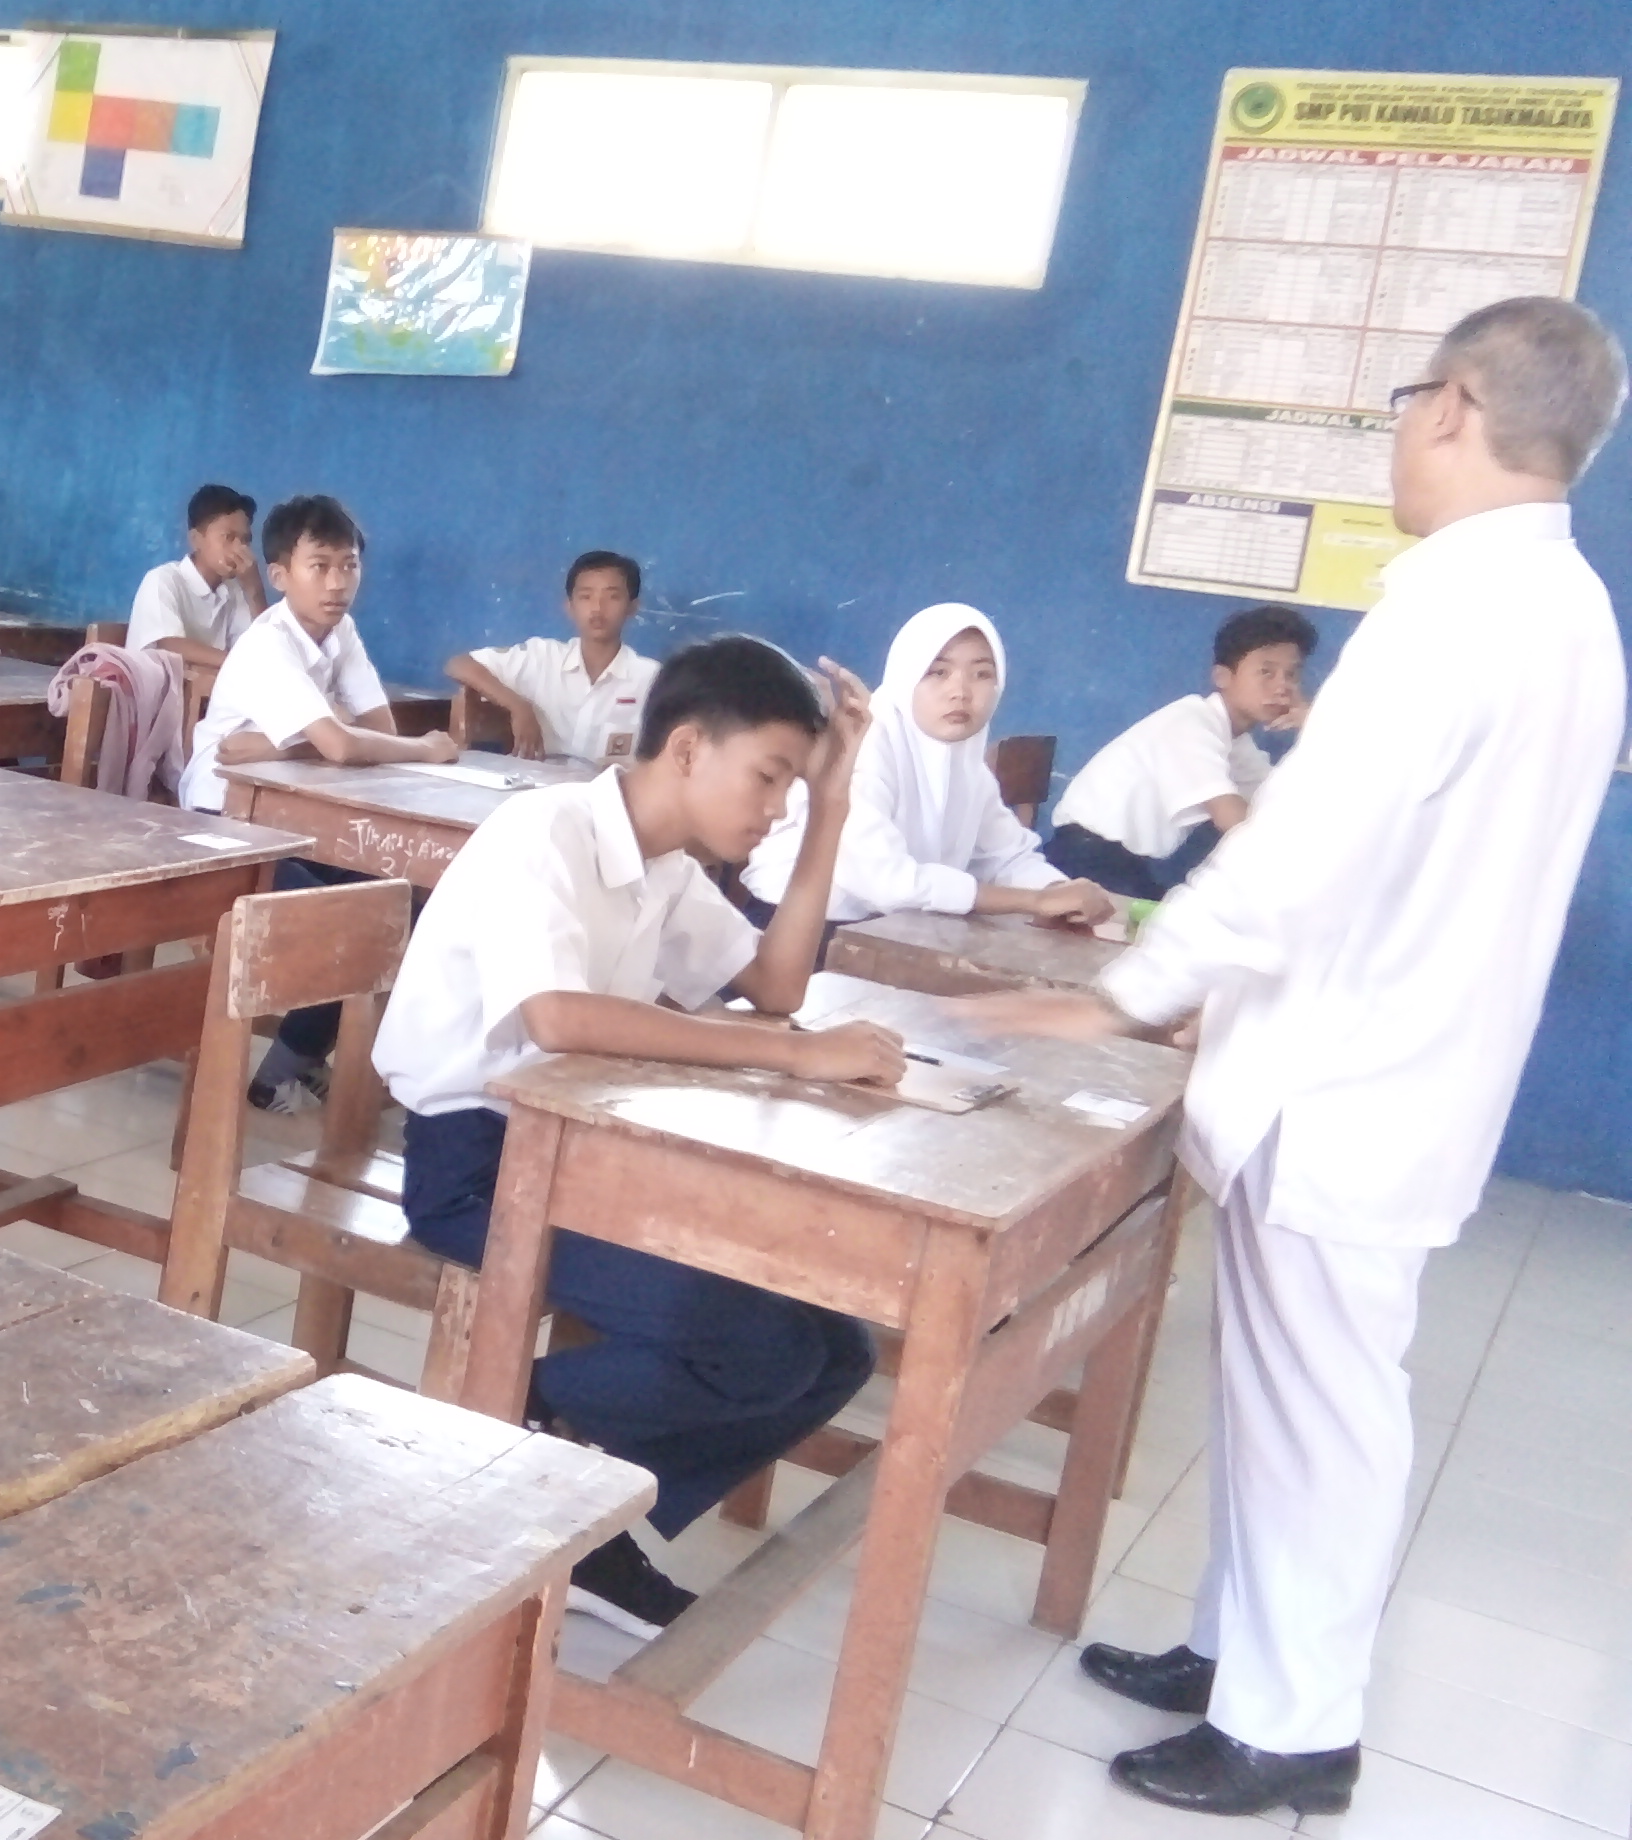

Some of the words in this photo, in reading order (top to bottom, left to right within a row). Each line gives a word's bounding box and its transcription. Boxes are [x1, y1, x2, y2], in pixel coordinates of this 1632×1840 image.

[1294, 101, 1336, 121] SMP
[1461, 106, 1594, 129] TASIKMALAYA
[1236, 146, 1368, 165] JADWAL
[1374, 150, 1575, 172] PELAJARAN
[1264, 409, 1357, 429] JADWAL
[1360, 416, 1399, 431] PIK
[1187, 493, 1281, 513] ABSENSI
